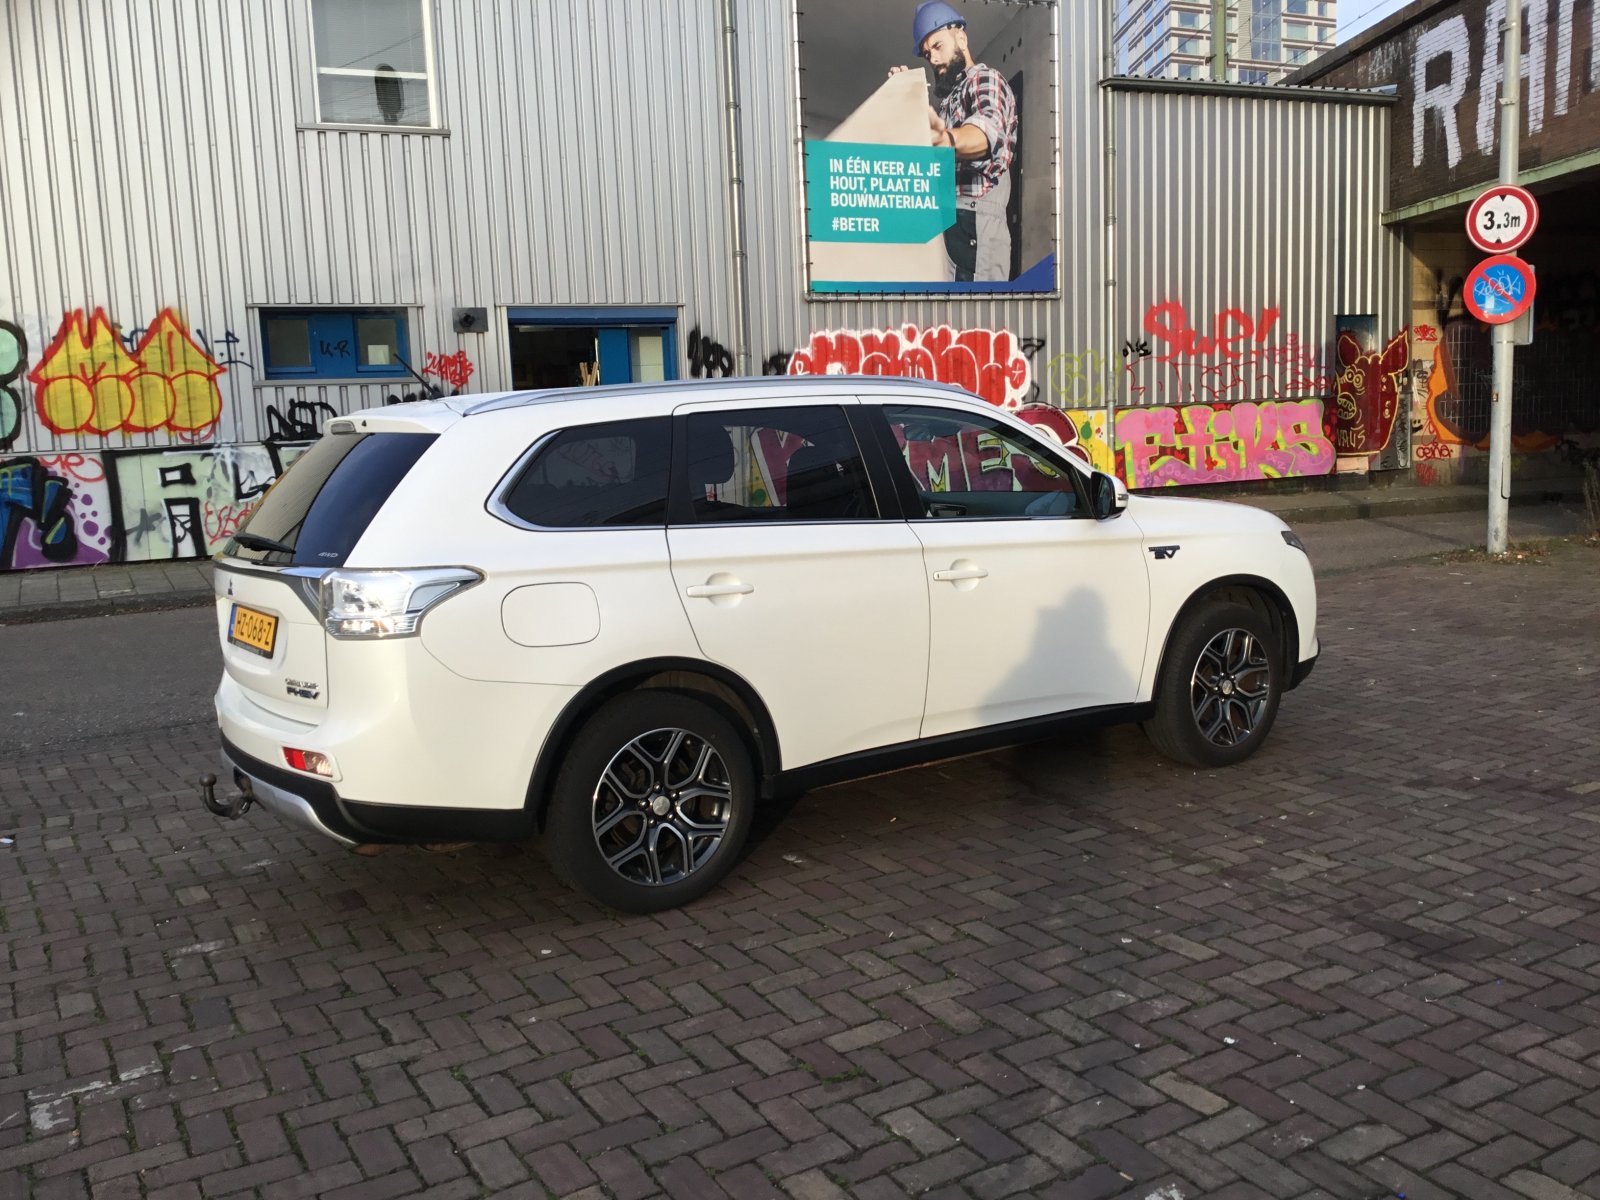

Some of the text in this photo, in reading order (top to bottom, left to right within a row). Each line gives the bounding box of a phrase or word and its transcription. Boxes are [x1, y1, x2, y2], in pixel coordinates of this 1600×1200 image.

[829, 155, 941, 177] IN ÉÉN KEER AL JE
[829, 175, 930, 194] HOUT, PLAAT EN
[830, 192, 940, 210] BOUWMATERIAAL
[831, 217, 880, 232] #BETER
[234, 610, 273, 647] HZ-068-Z
